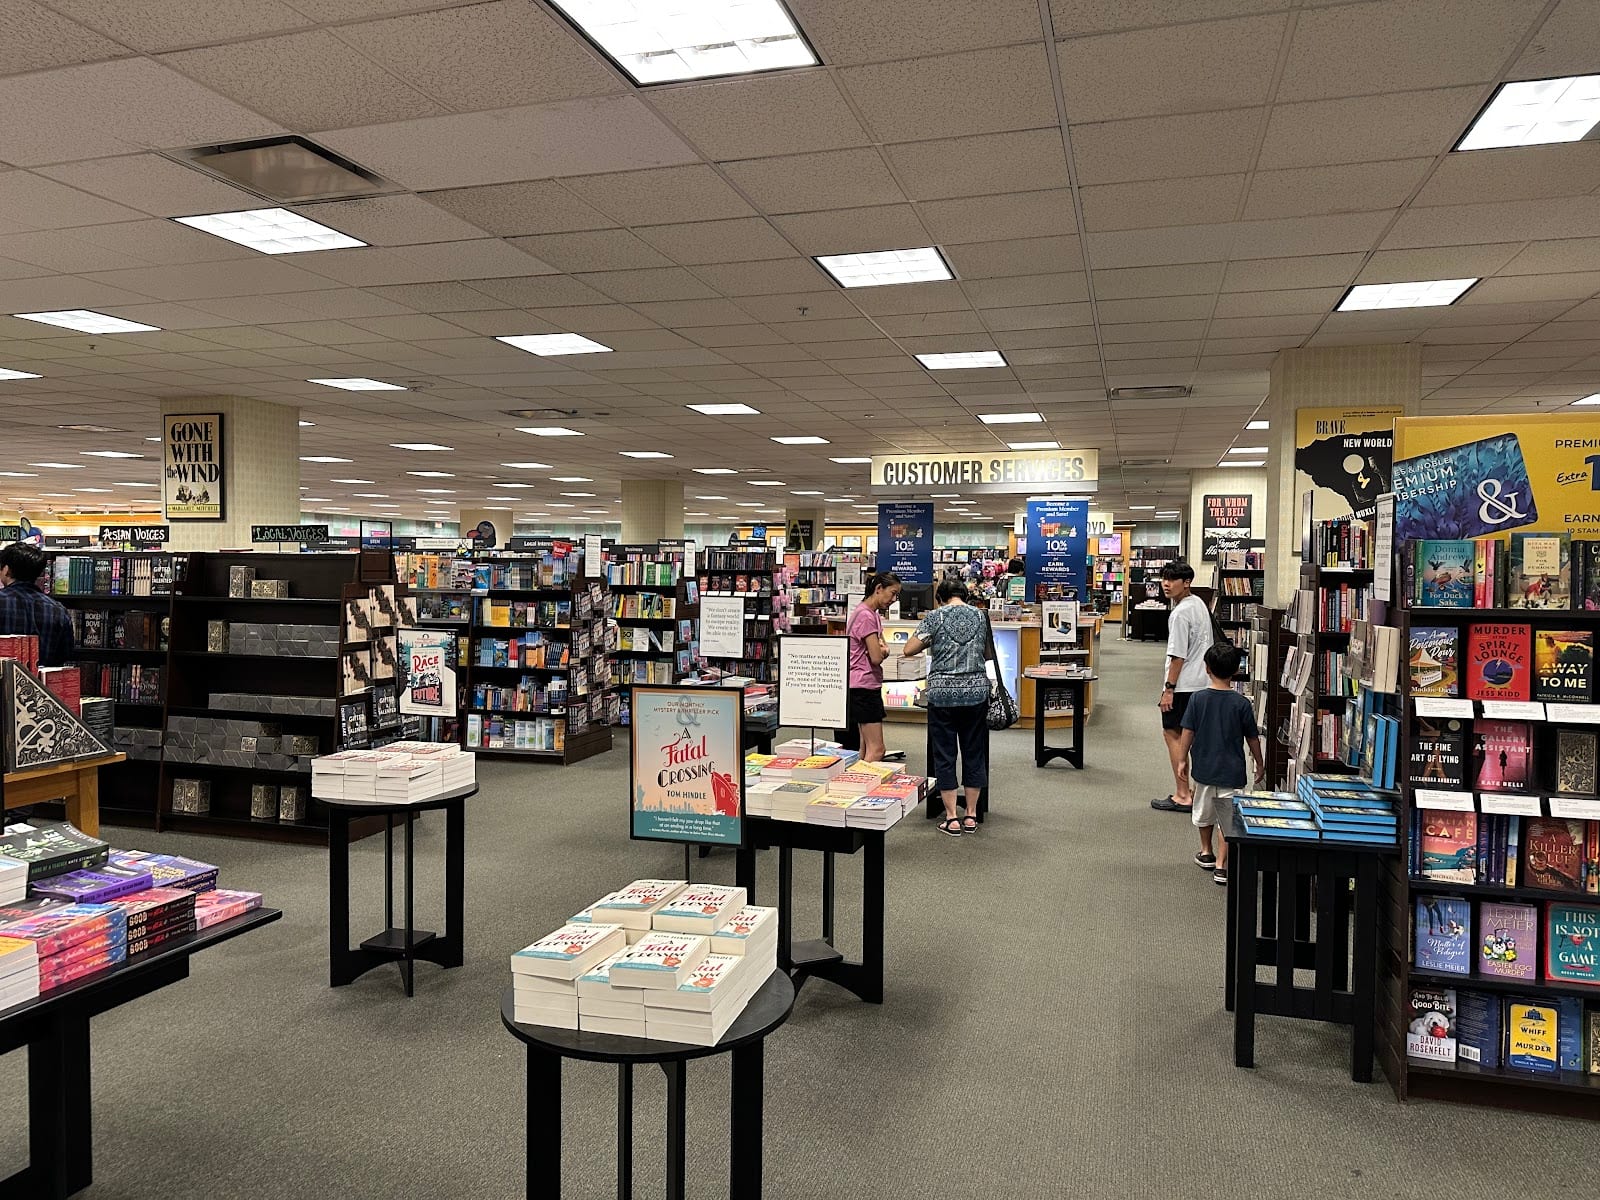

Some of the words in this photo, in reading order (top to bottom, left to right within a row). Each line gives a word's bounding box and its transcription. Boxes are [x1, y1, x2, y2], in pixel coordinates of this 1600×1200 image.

[171, 422, 213, 442] GONE
[1316, 420, 1346, 434] BRAVE
[1343, 439, 1361, 448] NEW
[1363, 438, 1393, 448] WORLD
[170, 443, 213, 462] WITH
[1417, 457, 1450, 471] NOBLE
[166, 465, 178, 478] the
[176, 463, 219, 483] WIND
[883, 460, 983, 485] CUSTOMER
[989, 457, 1085, 482] SERVICES
[1557, 472, 1588, 484] Extra
[1207, 498, 1222, 507] FOR
[1225, 497, 1248, 507] WHOM
[1209, 508, 1224, 517] THE
[1227, 507, 1245, 517] BELL
[1216, 517, 1238, 527] TOLLS
[1564, 514, 1600, 523] EARN
[102, 528, 131, 541] ASIAN
[134, 528, 165, 541] VOICES
[255, 527, 288, 540] LOCAL
[289, 527, 325, 540] VOICES
[894, 541, 914, 551] 10%
[1045, 540, 1067, 551] 10%
[1217, 538, 1240, 549] Ernest
[1435, 545, 1465, 553] Donna
[1430, 552, 1470, 561] Andrews
[1429, 630, 1437, 639] A
[1474, 626, 1526, 635] MURDER
[1409, 637, 1455, 651] Poisonous
[1479, 640, 1520, 652] SPIRIT
[1429, 646, 1455, 659] Pour
[1474, 650, 1524, 664] LOUNGE
[412, 655, 439, 673] RACE
[1539, 663, 1588, 674] AWAY
[1540, 677, 1561, 687] TO
[1564, 678, 1587, 688] ME
[413, 686, 440, 701] FUTURE
[681, 727, 691, 738] A
[1481, 735, 1525, 744] GALLERY
[661, 733, 709, 767] Fatal
[1419, 742, 1433, 751] THE
[1435, 743, 1452, 751] FINE
[1475, 743, 1531, 753] ASSISTANT
[1410, 753, 1425, 762] ART
[1427, 754, 1436, 762] OF
[1438, 755, 1459, 764] LYING
[658, 760, 716, 788] CROSSING
[1409, 775, 1436, 783] ALEXANDRA
[682, 791, 707, 799] HINDLE
[1426, 816, 1474, 827] ITALIAN
[1548, 834, 1556, 843] A
[1530, 840, 1577, 854] KILLER
[1489, 908, 1529, 920] LESLIE
[1565, 912, 1596, 924] THIS
[1487, 918, 1534, 931] MEIER
[1555, 924, 1568, 935] IS
[1572, 925, 1600, 938] NOT
[1428, 938, 1455, 948] Matter
[1458, 941, 1465, 949] of
[1584, 941, 1593, 951] A
[1433, 946, 1465, 960] Pedigree
[1558, 951, 1598, 966] GAME
[1422, 960, 1443, 968] LESLIE
[1445, 963, 1465, 972] MEIER
[1487, 960, 1513, 970] EASTER
[1515, 963, 1532, 972] EGG
[1494, 967, 1525, 976] MURDER
[1411, 999, 1433, 1010] GOOD
[1433, 1001, 1450, 1011] BITE
[1521, 1027, 1547, 1036] WHIFF
[1420, 1036, 1442, 1046] DAVID
[1515, 1041, 1552, 1053] MURDER
[1410, 1042, 1451, 1057] ROSENFELT
